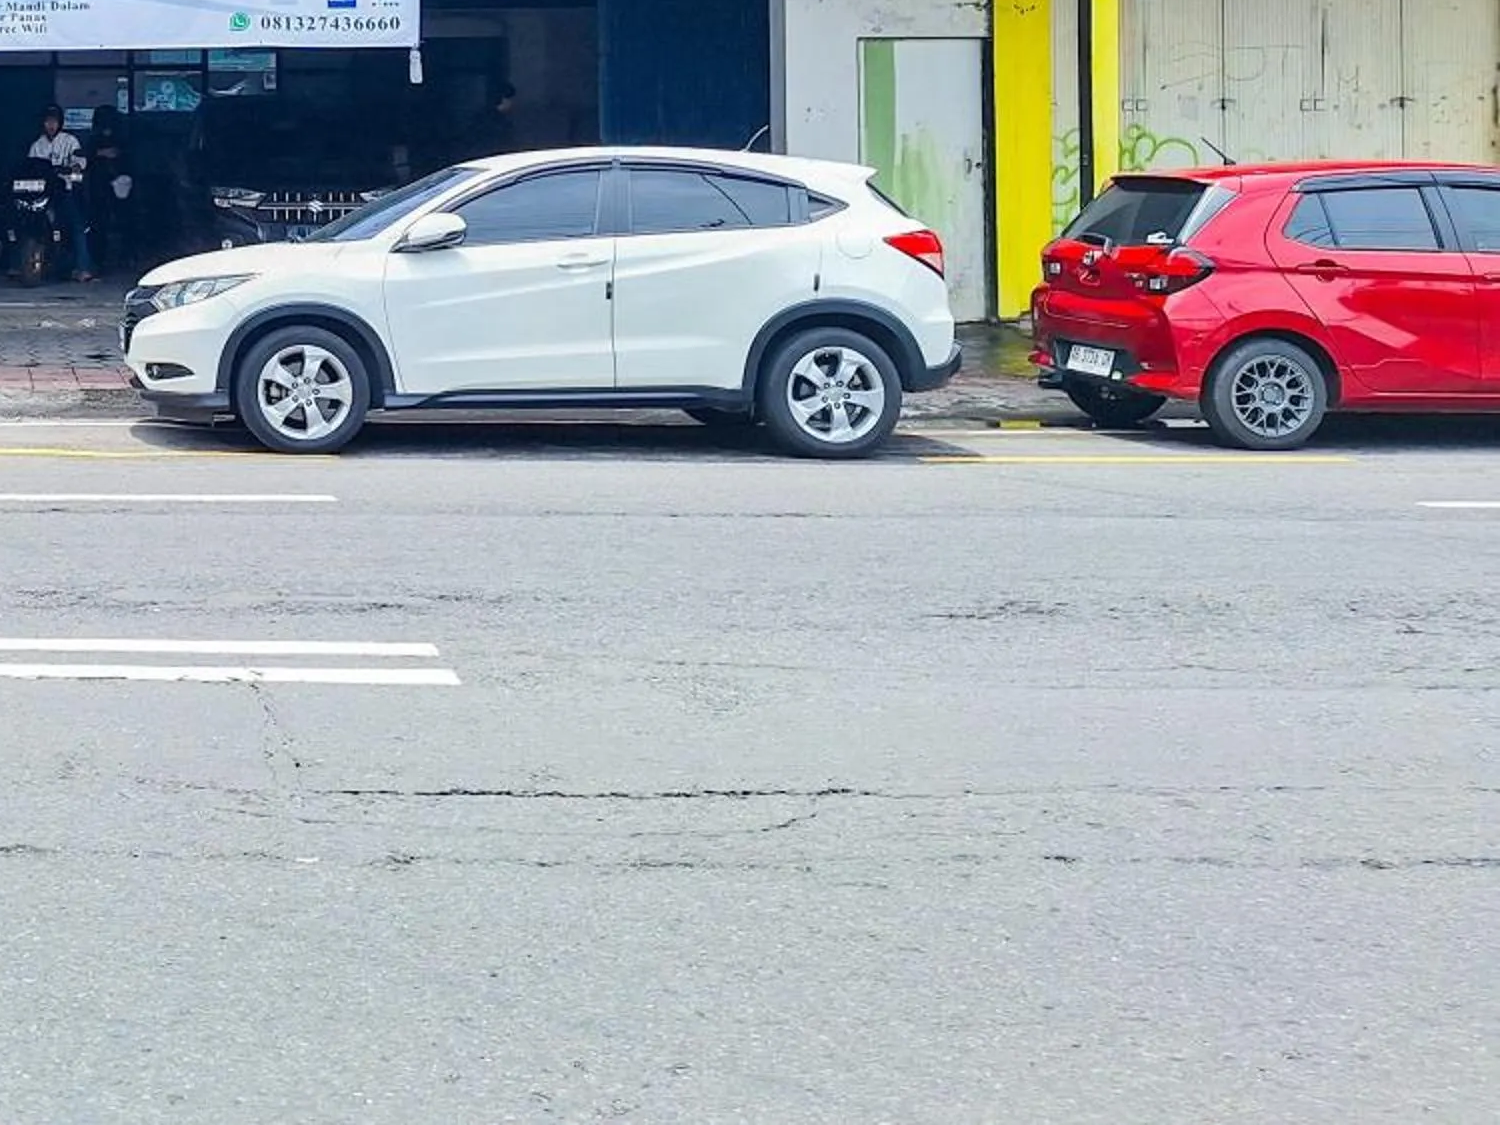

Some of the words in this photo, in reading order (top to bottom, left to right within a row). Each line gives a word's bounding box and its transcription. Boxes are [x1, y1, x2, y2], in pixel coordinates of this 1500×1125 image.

[4, 1, 46, 12] Mandi
[51, 1, 91, 11] Dalam
[261, 16, 401, 31] 081327436660
